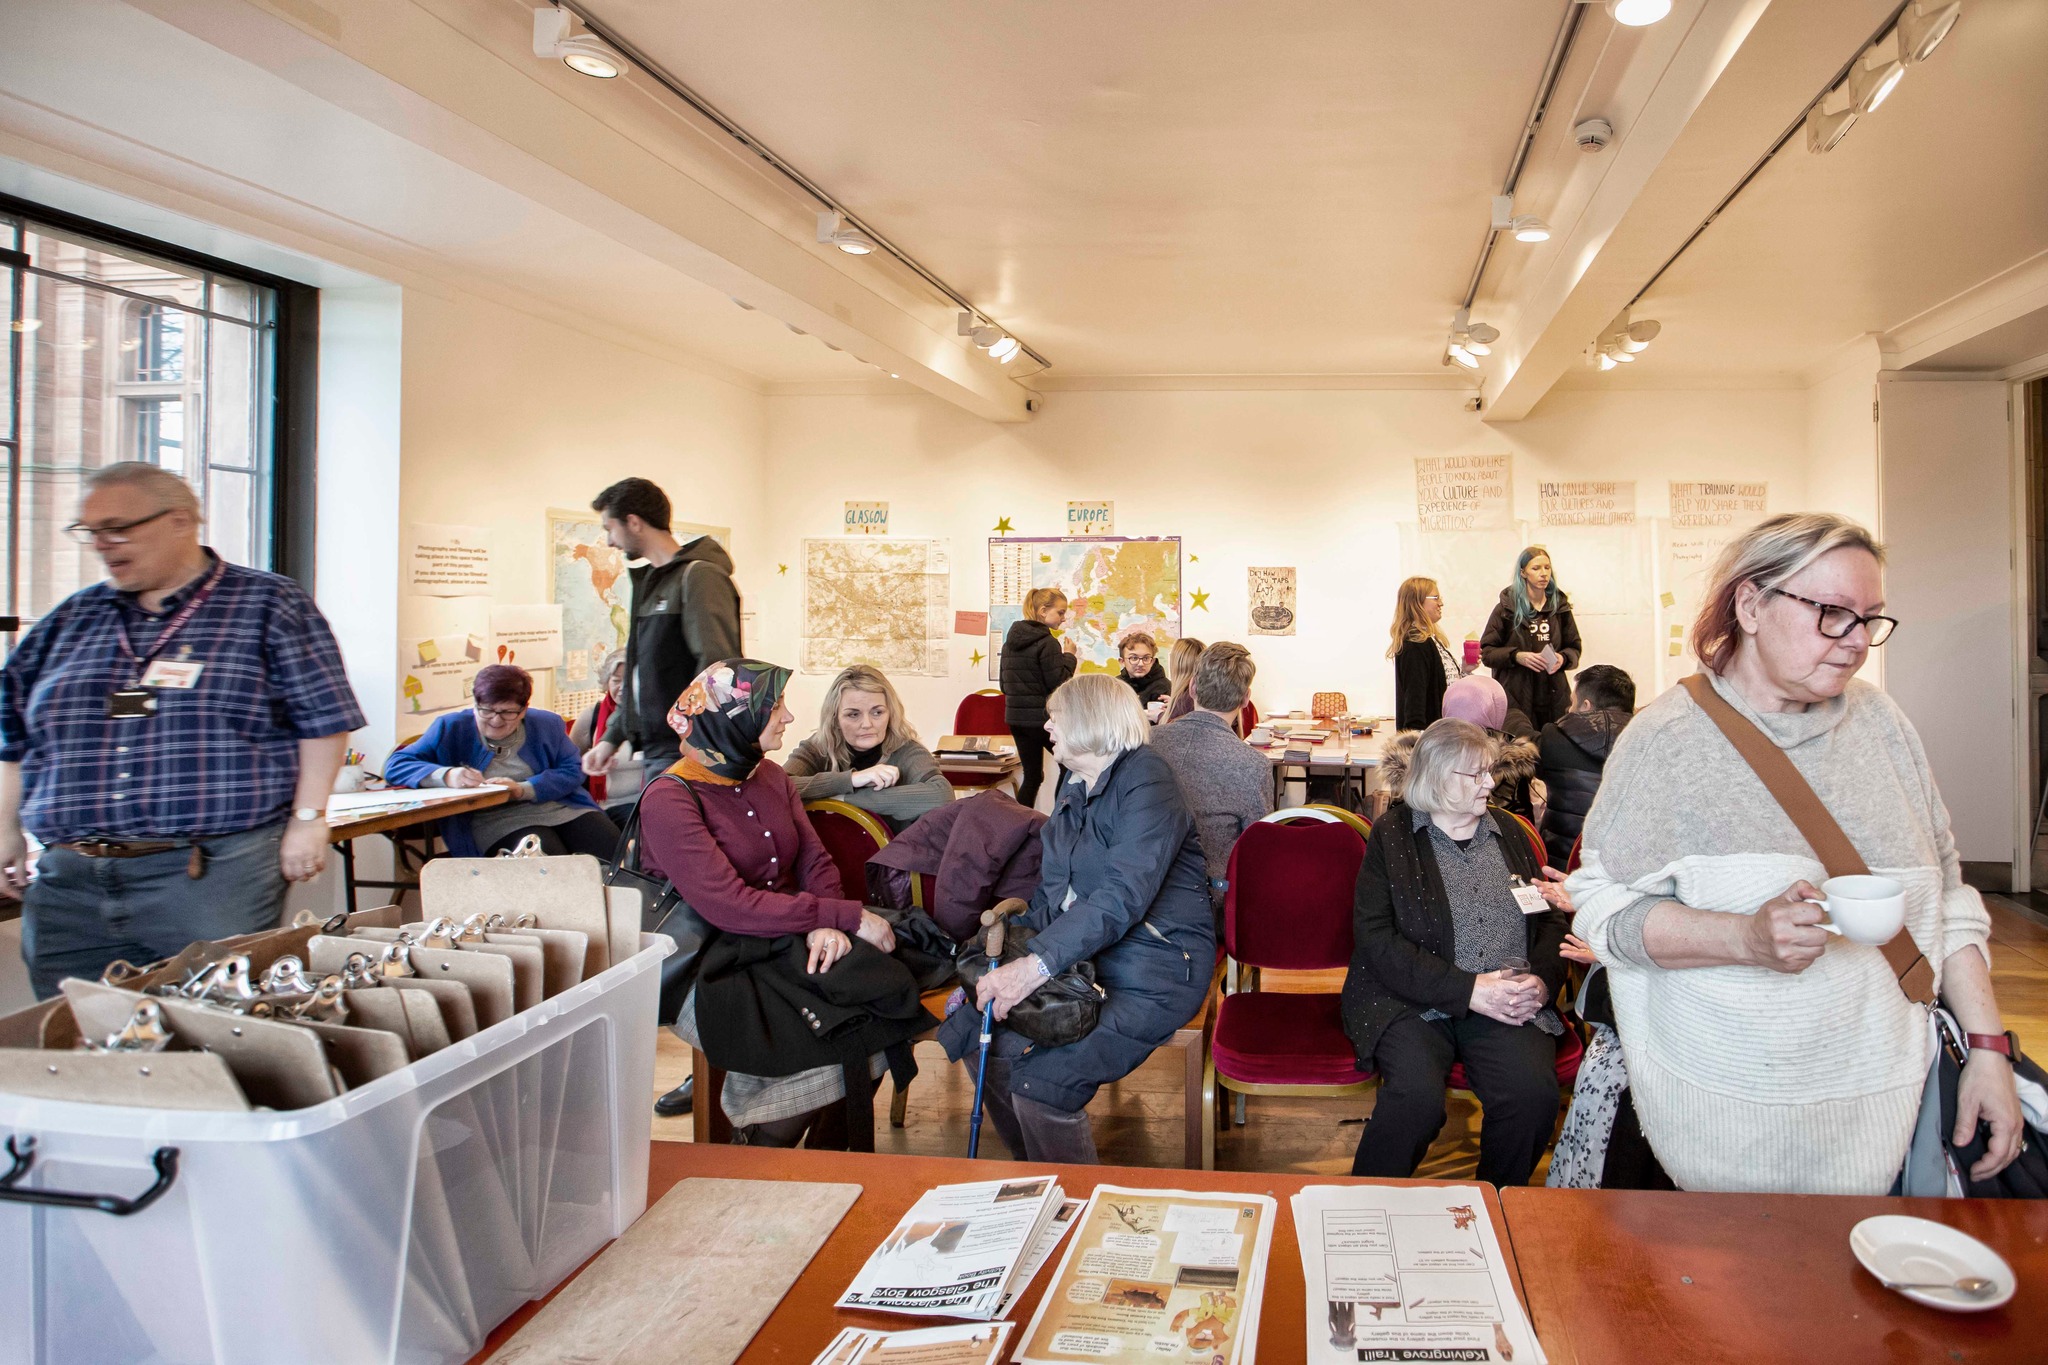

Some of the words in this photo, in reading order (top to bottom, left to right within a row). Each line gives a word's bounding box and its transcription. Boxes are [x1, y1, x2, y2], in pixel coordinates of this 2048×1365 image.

[1417, 458, 1440, 474] WHAT
[1444, 456, 1467, 469] WOULD
[1470, 456, 1484, 467] YOU
[1486, 456, 1505, 467] LIKE
[1417, 473, 1443, 486] PEOPLE
[1445, 472, 1454, 482] TO
[1454, 472, 1476, 480] KNOW
[1478, 470, 1498, 480] ABOUT
[1418, 486, 1440, 501] YOUR
[1442, 485, 1478, 500] CULTURE
[1482, 486, 1502, 498] AND
[1540, 482, 1560, 498] HOW
[1562, 482, 1576, 496] CAN
[1578, 483, 1590, 496] WE
[1592, 482, 1616, 495] SHARE
[1671, 484, 1692, 498] WHAT
[1698, 484, 1735, 496] TRAINING
[1738, 486, 1766, 496] WOULD
[1418, 501, 1468, 515] EXPERIENCE
[1470, 502, 1480, 510] OF
[1540, 498, 1558, 514] OUR
[1562, 498, 1594, 510] CULTURES
[1596, 500, 1614, 510] AND
[1672, 499, 1692, 514] HELP
[1694, 498, 1710, 511] YOU
[1712, 499, 1738, 512] SHARE
[1742, 500, 1765, 512] THESE
[846, 510, 888, 524] GLASGOW
[1068, 509, 1109, 522] EUROPE
[1542, 512, 1585, 526] EXPERIENCES
[1588, 512, 1606, 525] WITH
[1672, 514, 1732, 526] EXPERIENCES?
[1420, 515, 1474, 532] MIGRATION?
[958, 1272, 977, 1280] Book
[978, 1266, 1004, 1276] Activity
[972, 1278, 998, 1289] The
[872, 1288, 908, 1299] Boys
[910, 1286, 969, 1298] Glasgow
[1364, 1350, 1400, 1361] Trail!
[1403, 1350, 1486, 1360] Kelvingrove
